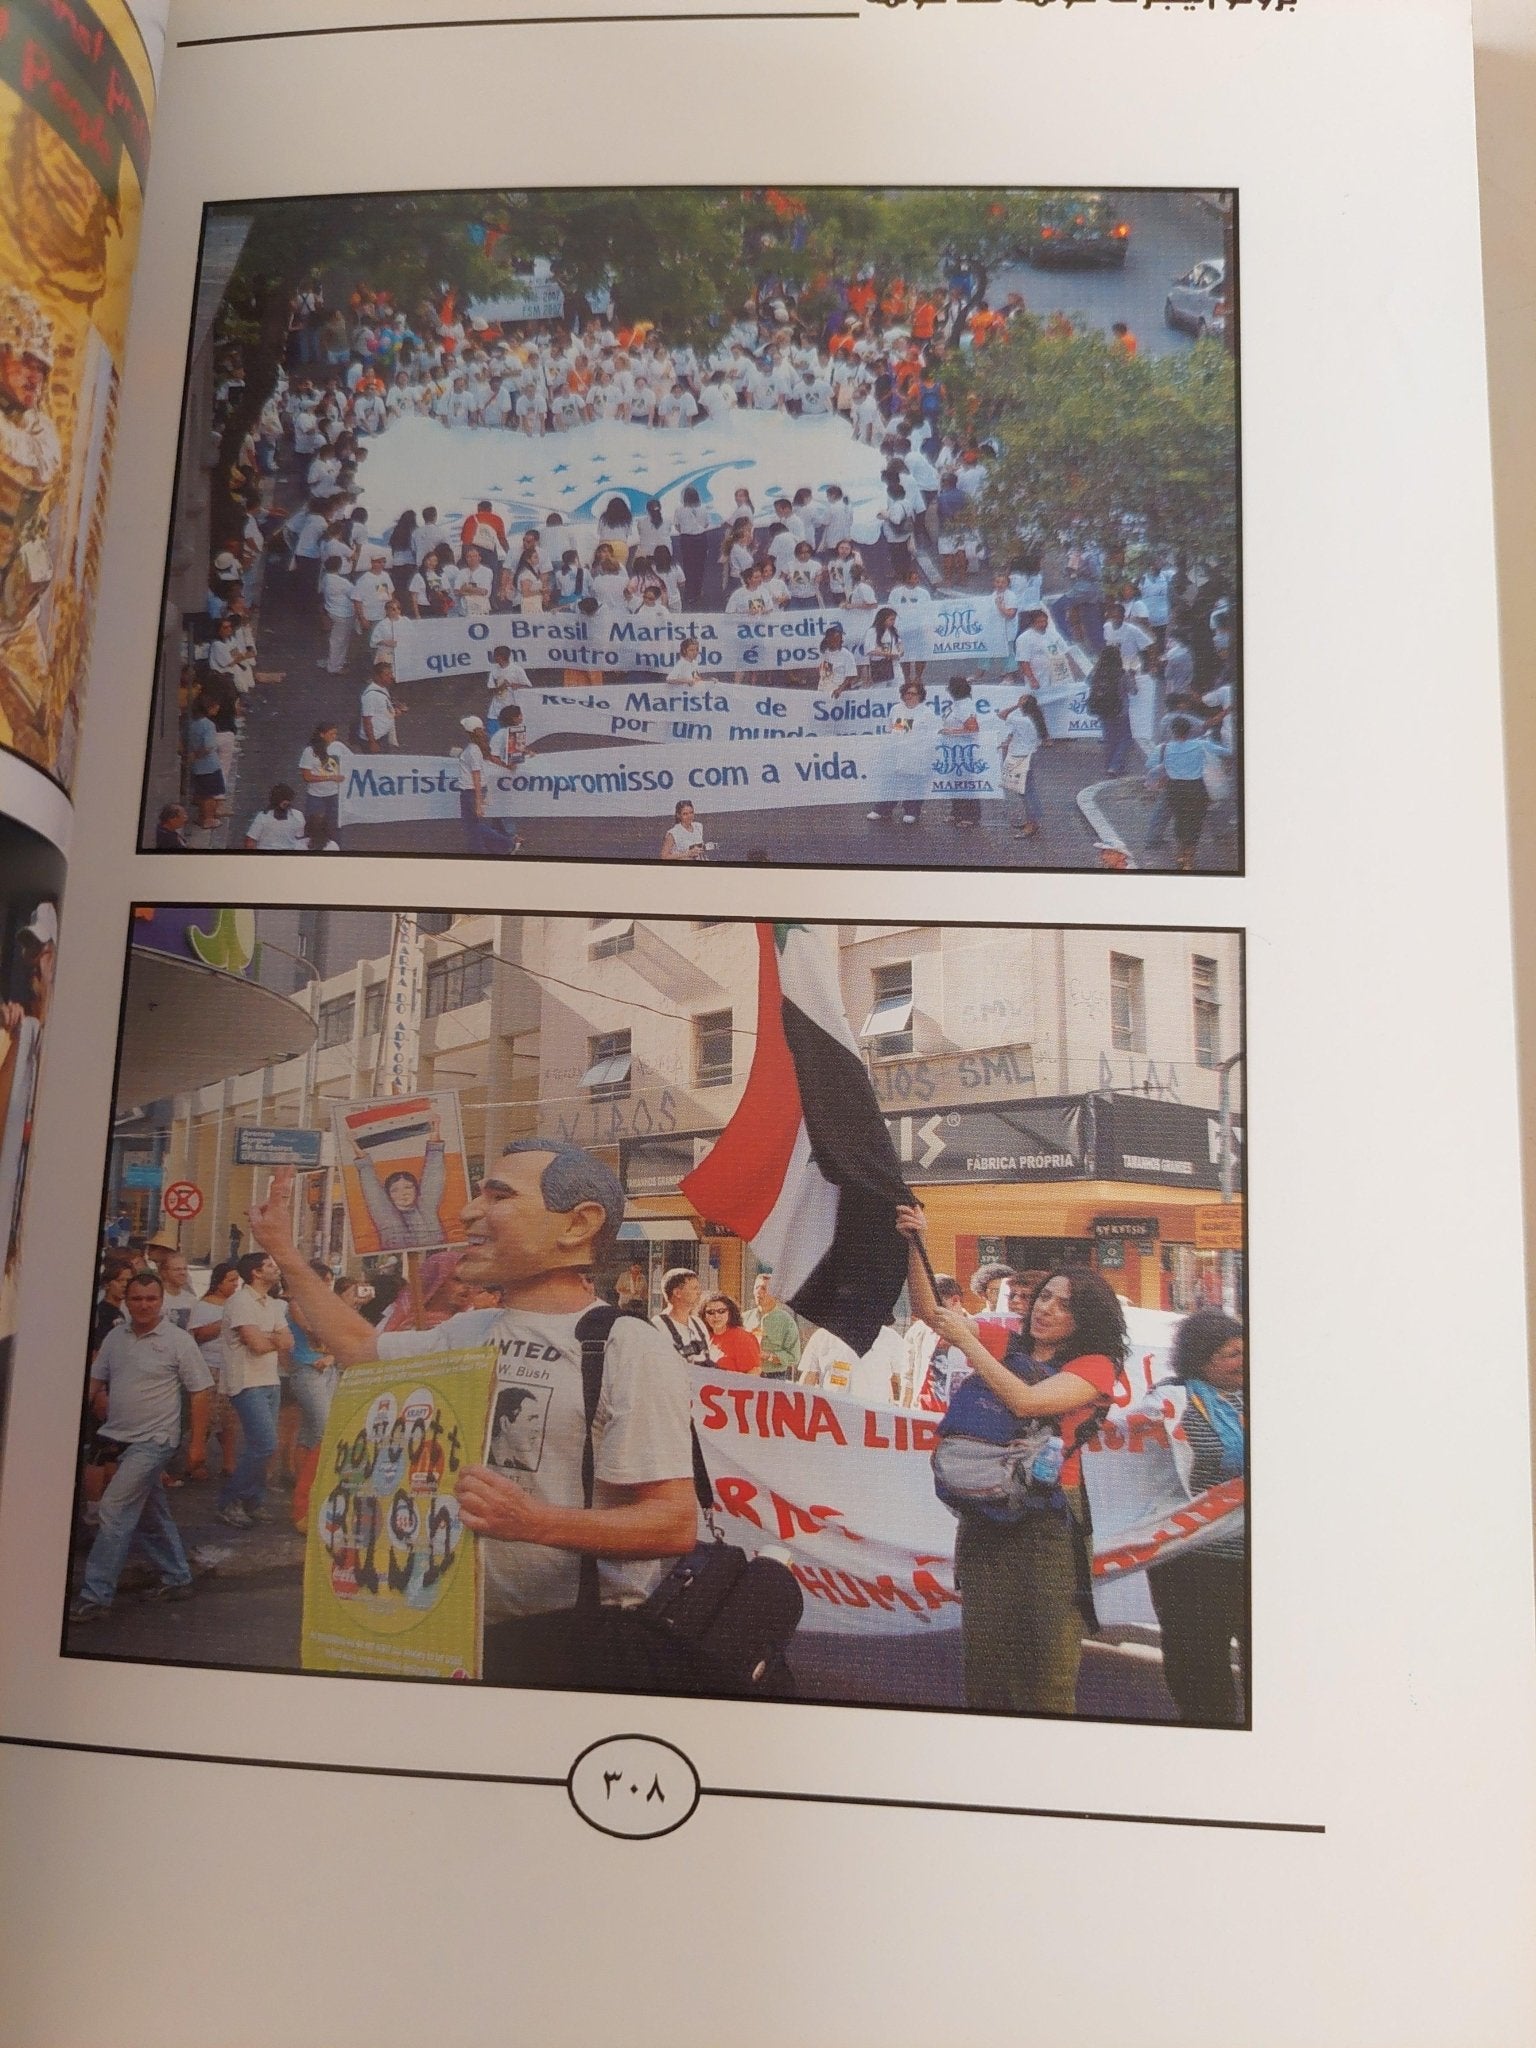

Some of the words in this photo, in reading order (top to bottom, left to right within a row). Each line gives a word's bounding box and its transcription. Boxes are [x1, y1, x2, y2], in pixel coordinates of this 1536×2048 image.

[468, 623, 490, 641] O
[512, 620, 588, 641] Brasil
[609, 621, 718, 642] Marista
[737, 616, 843, 639] acredita
[426, 651, 472, 673] que
[548, 646, 619, 666] outro
[635, 646, 722, 669] mudo
[743, 645, 760, 664] é
[933, 641, 987, 652] MARISTA
[625, 689, 728, 713] Marista
[755, 697, 787, 717] de
[611, 716, 650, 734] por
[672, 722, 712, 740] um
[497, 763, 673, 799] compromisso
[688, 766, 749, 790] com
[761, 763, 780, 785] a
[795, 752, 867, 782] vida.
[932, 780, 993, 790] MARISTA
[966, 1153, 1017, 1171] FÁBRICA
[1020, 1152, 1074, 1170] PRÓPRIA
[516, 1366, 550, 1381] Bush
[603, 1769, 666, 1803] ٣٠٨
